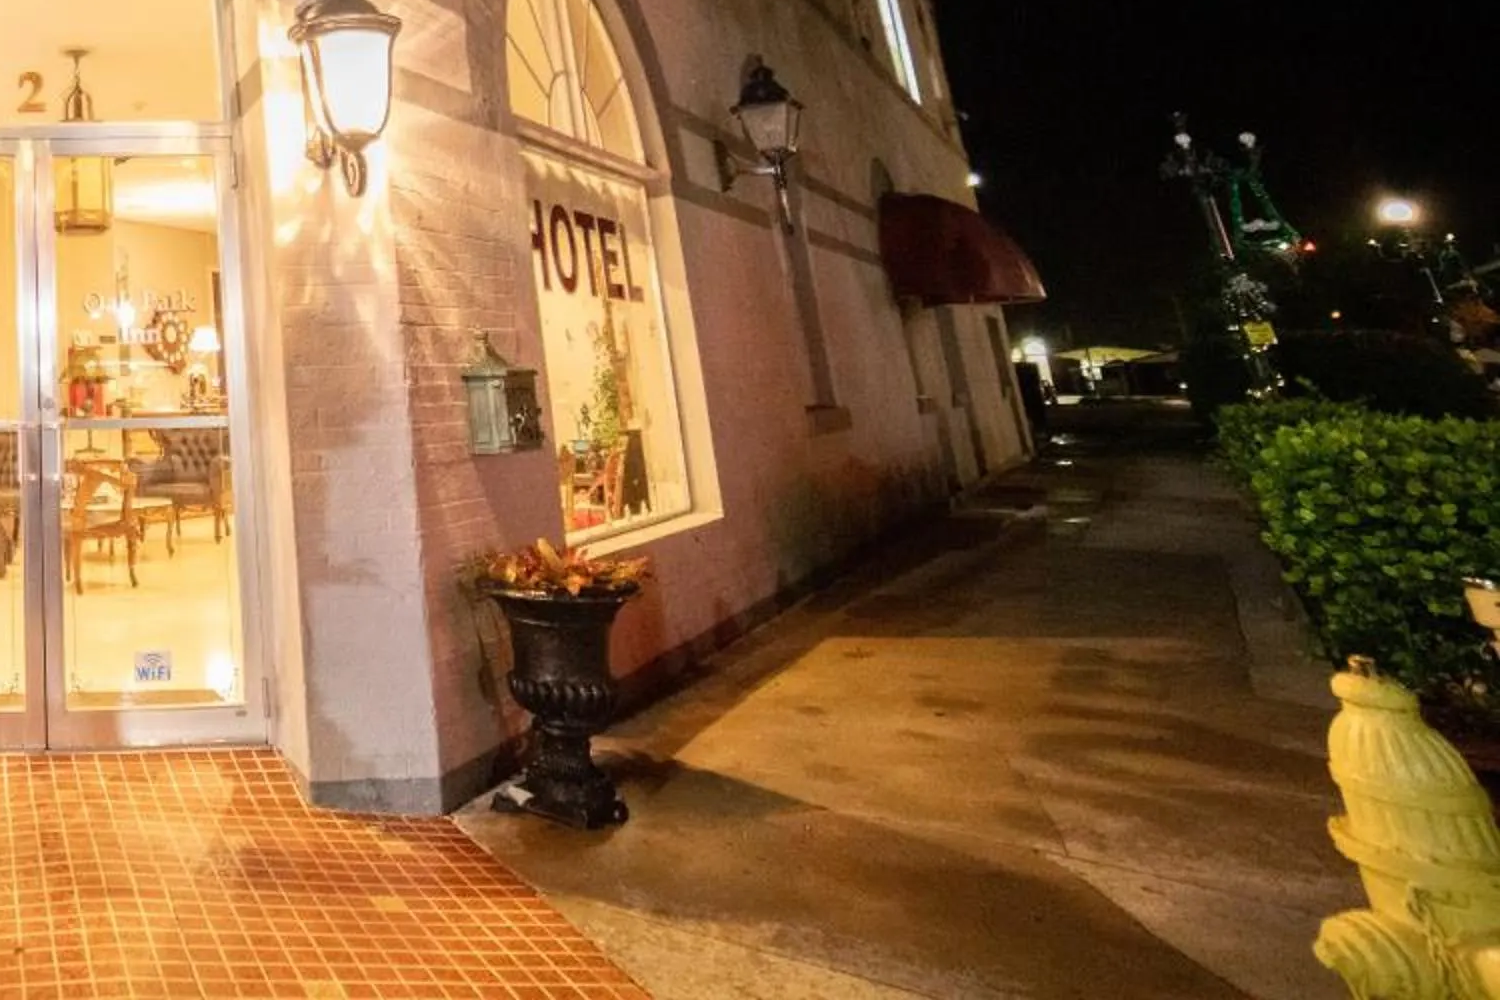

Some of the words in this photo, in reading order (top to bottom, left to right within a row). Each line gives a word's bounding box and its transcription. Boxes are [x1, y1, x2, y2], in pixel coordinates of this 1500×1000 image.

[17, 71, 47, 114] 2
[531, 199, 644, 303] HOTEL
[118, 327, 161, 345] Inn
